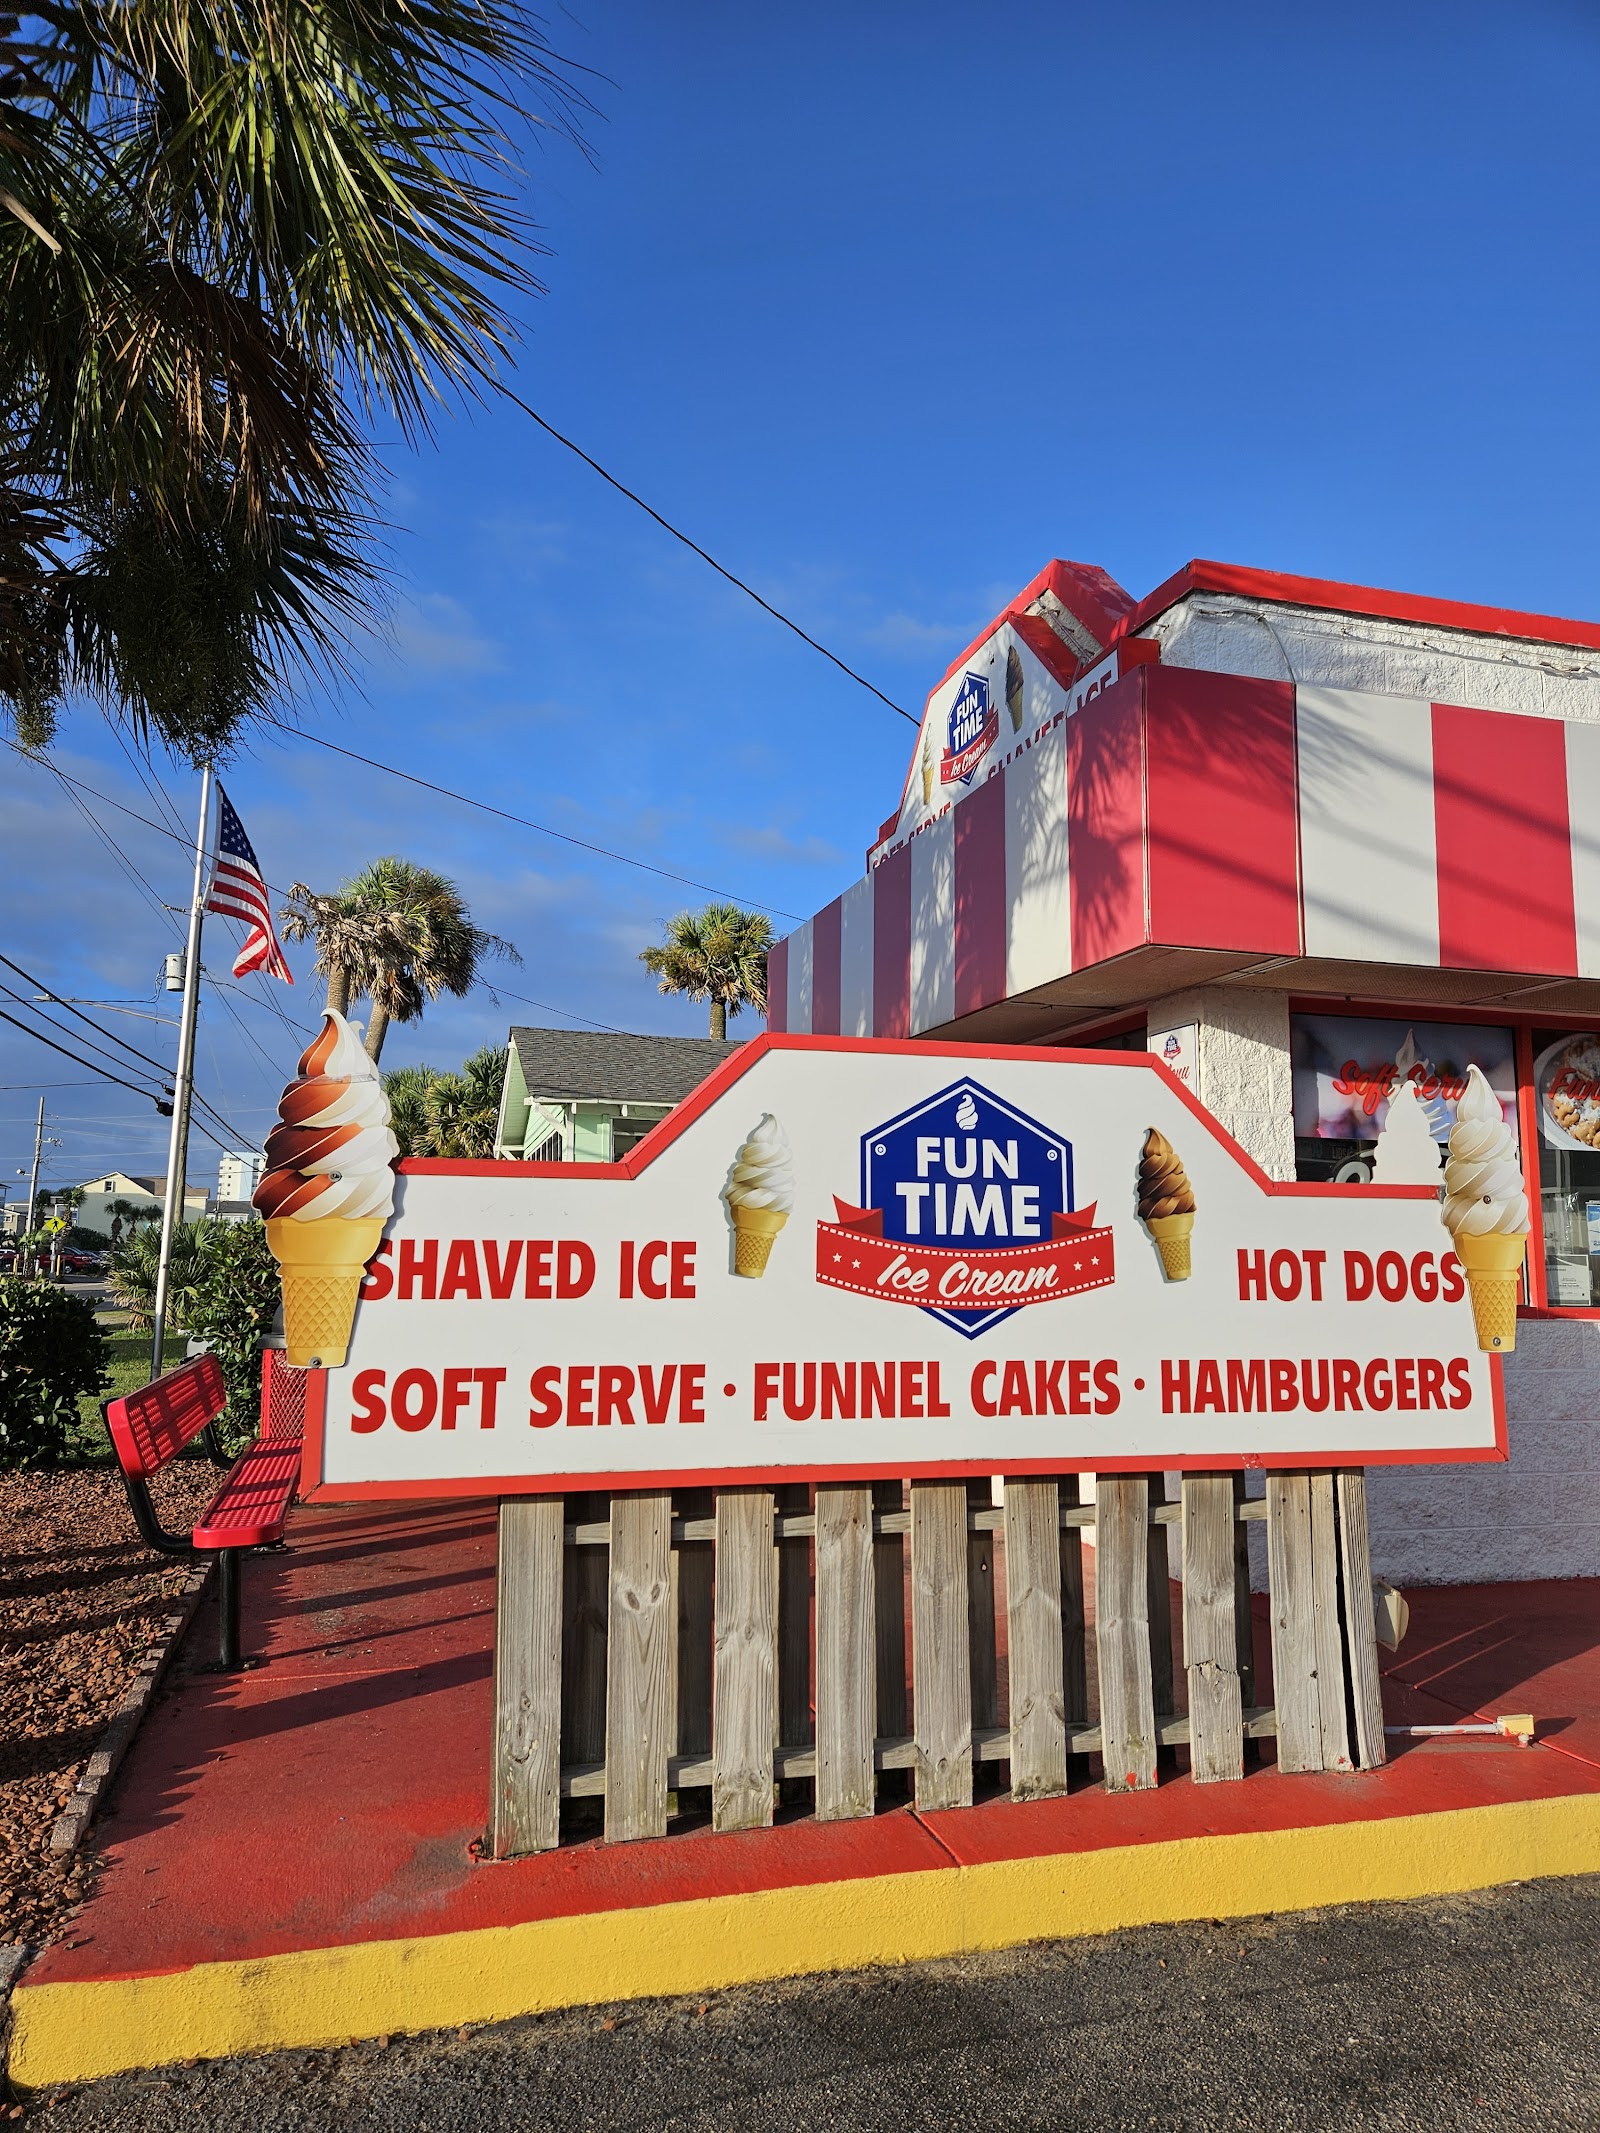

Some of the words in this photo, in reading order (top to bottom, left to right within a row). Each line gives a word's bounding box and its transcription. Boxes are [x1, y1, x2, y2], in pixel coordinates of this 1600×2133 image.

[953, 706, 983, 752] TIME
[956, 690, 978, 725] FUN
[950, 760, 961, 778] Ice
[961, 738, 987, 772] Cream
[1332, 1059, 1400, 1116] Soft
[1400, 1062, 1471, 1101] Serv
[916, 1136, 1019, 1179] FUN
[895, 1182, 1041, 1237] TIME
[359, 1238, 597, 1300] SHAVED
[619, 1240, 697, 1300] ICE
[876, 1253, 930, 1293] Ice
[938, 1260, 1059, 1299] Cream
[1237, 1248, 1327, 1302] HOT
[1344, 1250, 1465, 1303] DOGS
[350, 1366, 507, 1434] SOFT
[529, 1364, 706, 1429] SERVE
[753, 1361, 951, 1421] FUNNEL
[970, 1358, 1121, 1418] CAKES
[1161, 1357, 1472, 1414] HAMBURGERS
